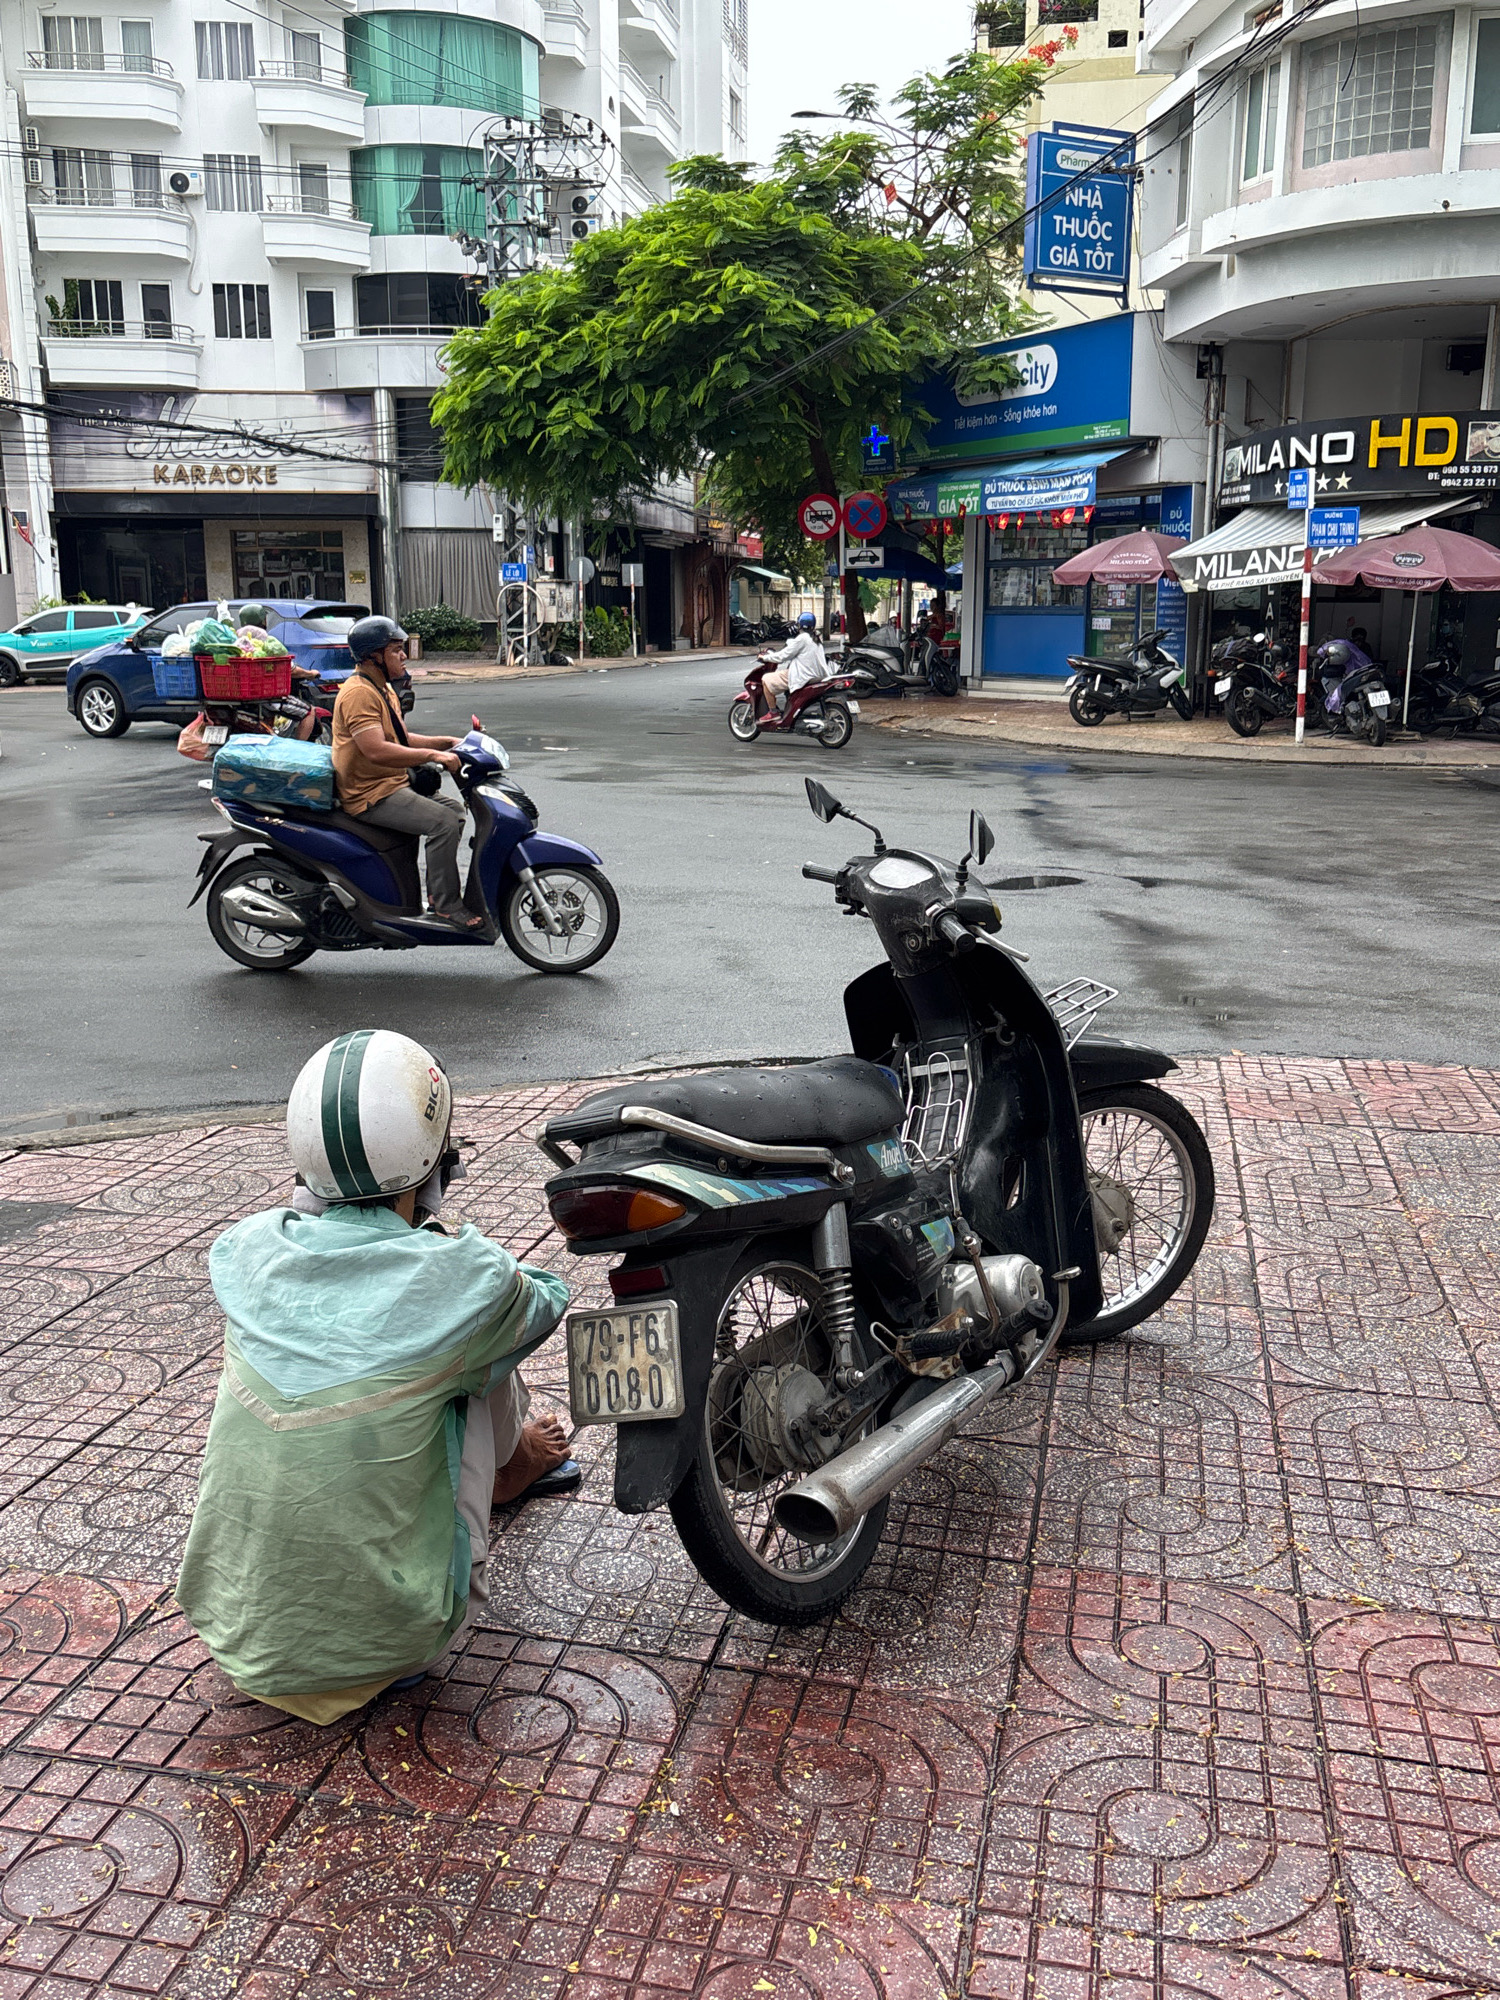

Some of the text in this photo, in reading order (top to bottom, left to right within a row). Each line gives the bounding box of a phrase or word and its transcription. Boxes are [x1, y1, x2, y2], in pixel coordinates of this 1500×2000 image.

[1065, 185, 1103, 210] NHÀ
[1053, 211, 1112, 241] THUỐC
[1050, 242, 1114, 271] GIÁ TỐT
[954, 414, 966, 430] Tiết
[966, 415, 982, 429] kiệm
[984, 414, 997, 425] hơn
[1003, 408, 1021, 423] Sống
[1042, 404, 1057, 417] hơn
[1238, 416, 1458, 476] MILANO HD
[153, 464, 278, 484] KARAOKE
[984, 479, 996, 494] ĐỦ
[997, 477, 1025, 494] THUỐC
[1026, 477, 1050, 494] BỆNH
[1441, 478, 1461, 487] 0942
[1487, 478, 1496, 486] 11
[938, 491, 979, 514] GIÁ TỐT
[1169, 506, 1182, 520] ĐỦ
[1161, 520, 1190, 533] THUỐC
[1312, 522, 1355, 537] PHAN CHU TRINH
[1220, 580, 1234, 588] PHÊ
[1270, 572, 1299, 583] NGUYÊN
[881, 1140, 903, 1171] Angel
[583, 1312, 660, 1365] 79-F6
[586, 1364, 664, 1415] 0080
